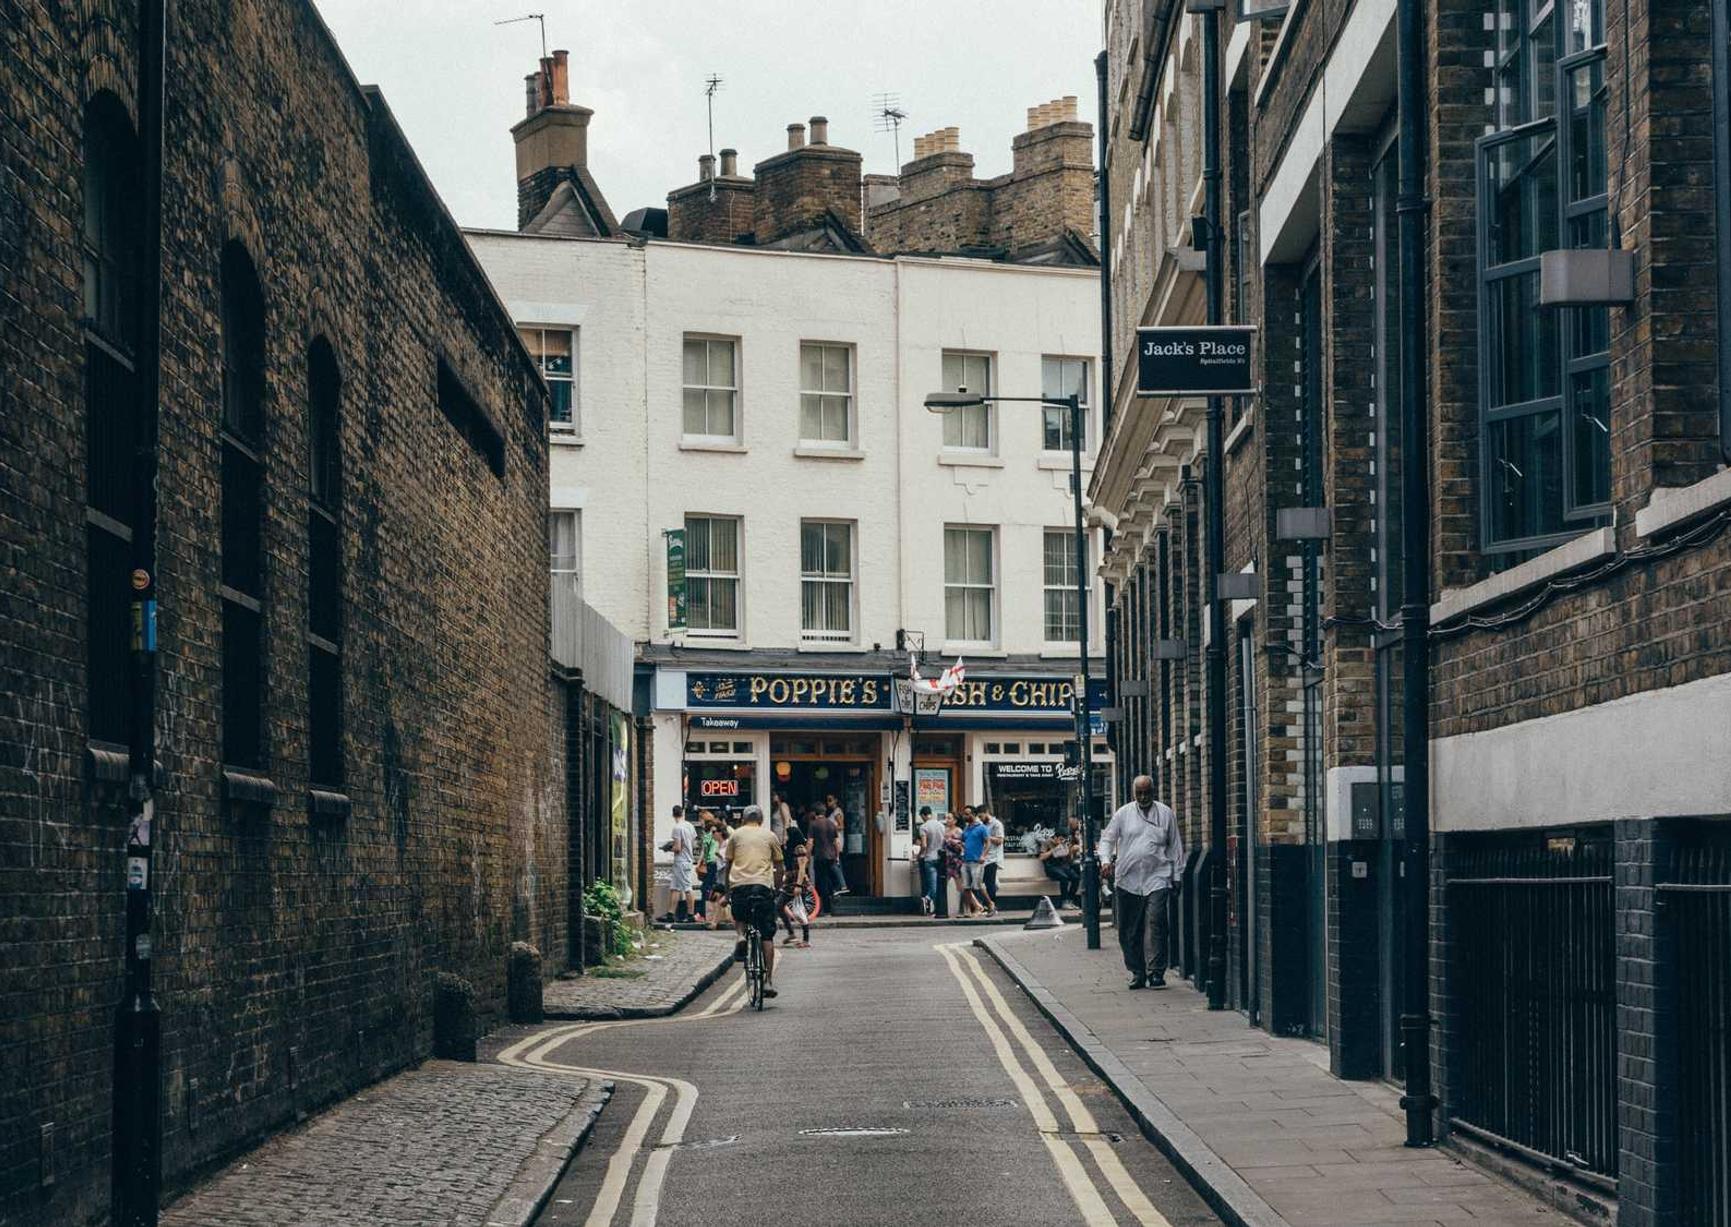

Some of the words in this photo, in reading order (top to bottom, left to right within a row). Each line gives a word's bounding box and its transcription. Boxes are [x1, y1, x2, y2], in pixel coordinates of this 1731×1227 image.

[1144, 342, 1194, 356] Jack's
[1200, 342, 1245, 355] Place
[751, 676, 877, 704] POPPIE'S
[991, 685, 1005, 701] &
[700, 717, 739, 729] Takeaway
[998, 765, 1039, 773] WELCOME
[1040, 765, 1052, 773] TO
[702, 781, 737, 795] OPEN
